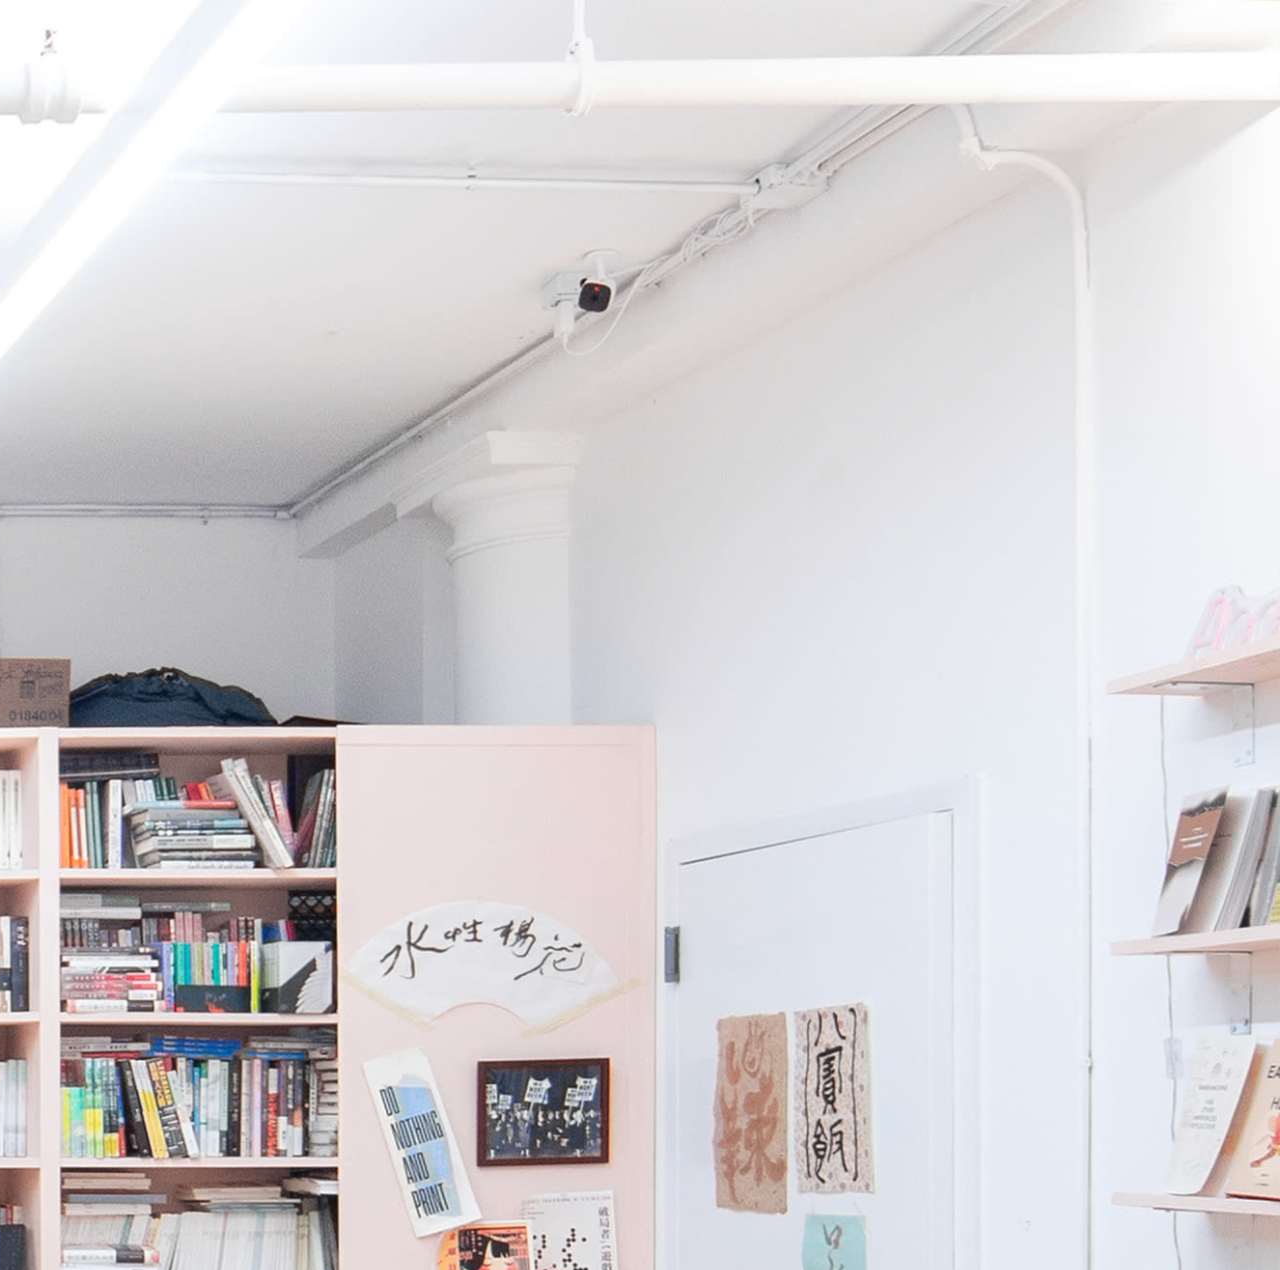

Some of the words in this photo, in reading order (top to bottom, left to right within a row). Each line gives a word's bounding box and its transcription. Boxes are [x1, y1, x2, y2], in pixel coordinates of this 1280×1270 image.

[379, 1086, 400, 1116] DO
[390, 1110, 445, 1151] NOTHING
[402, 1152, 430, 1184] AND
[411, 1183, 450, 1219] PRINT
